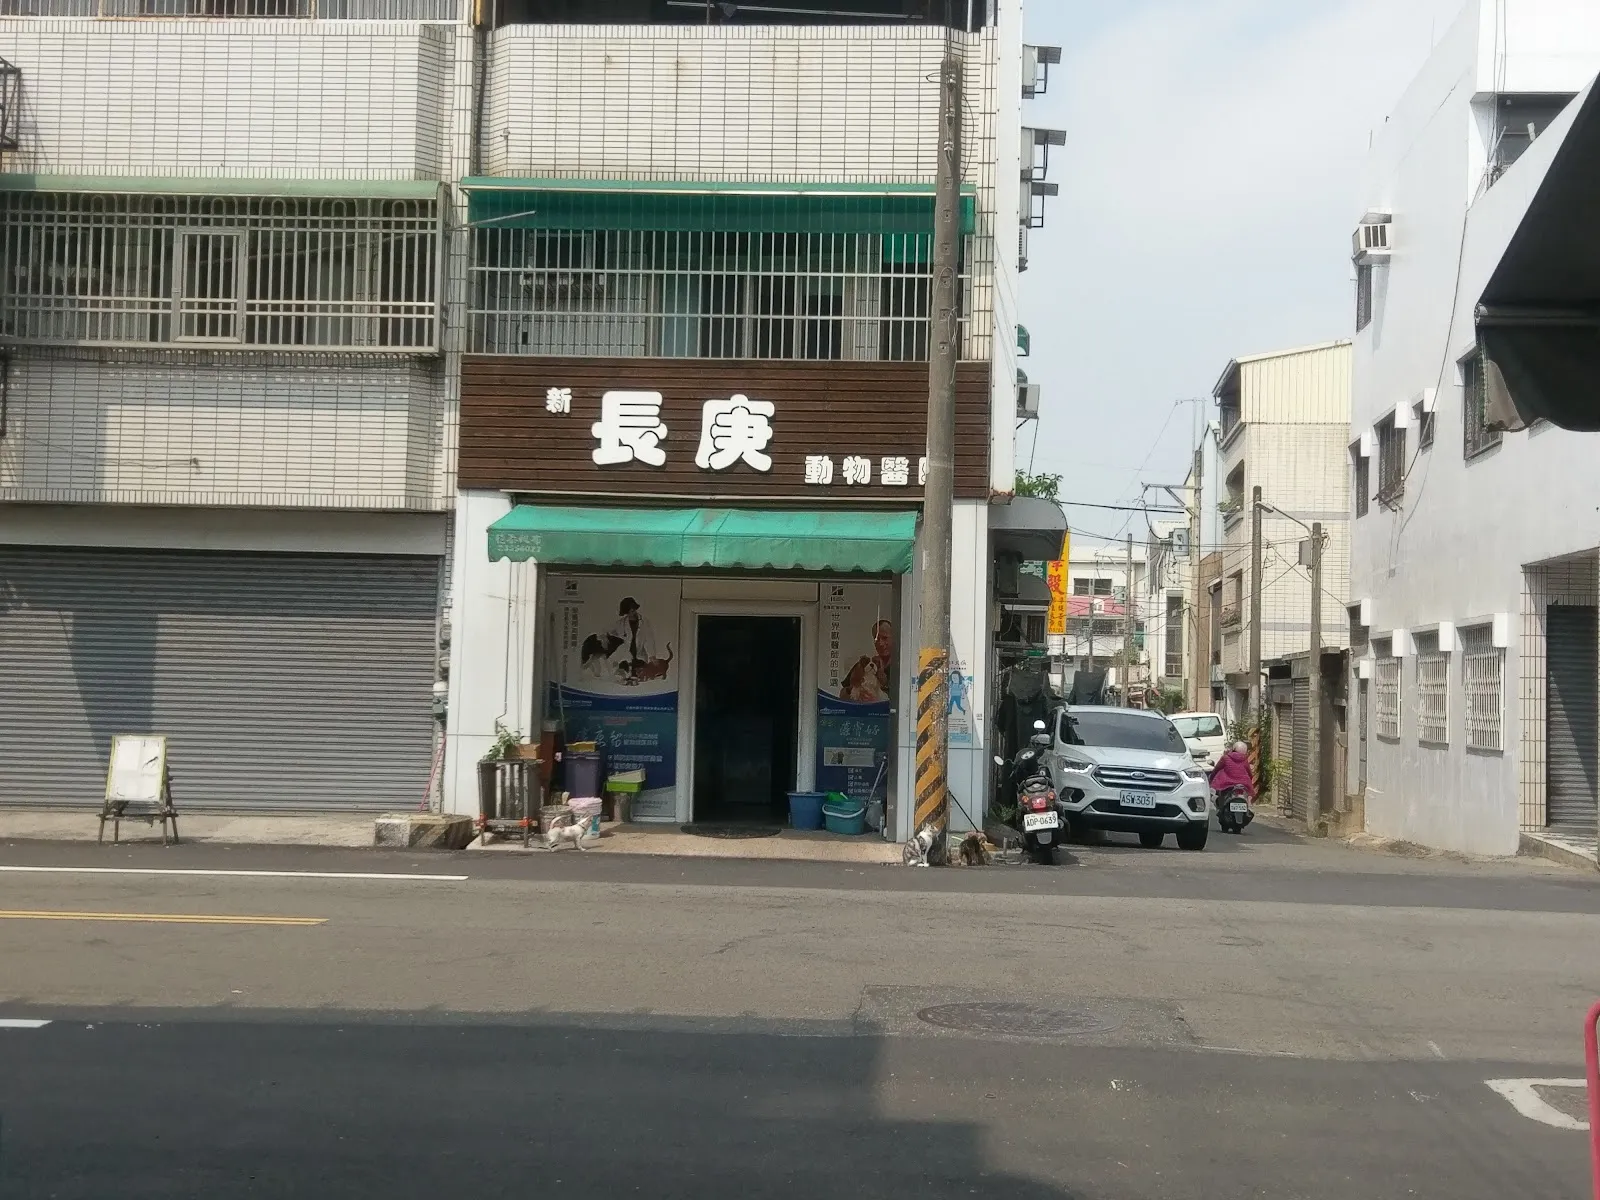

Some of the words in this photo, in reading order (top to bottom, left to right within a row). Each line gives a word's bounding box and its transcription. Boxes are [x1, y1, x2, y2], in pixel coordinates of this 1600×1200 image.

[545, 386, 572, 414] 新
[591, 390, 776, 472] 長庚
[1121, 794, 1155, 807] ASW-3031
[1026, 815, 1057, 828] ADP-0639
